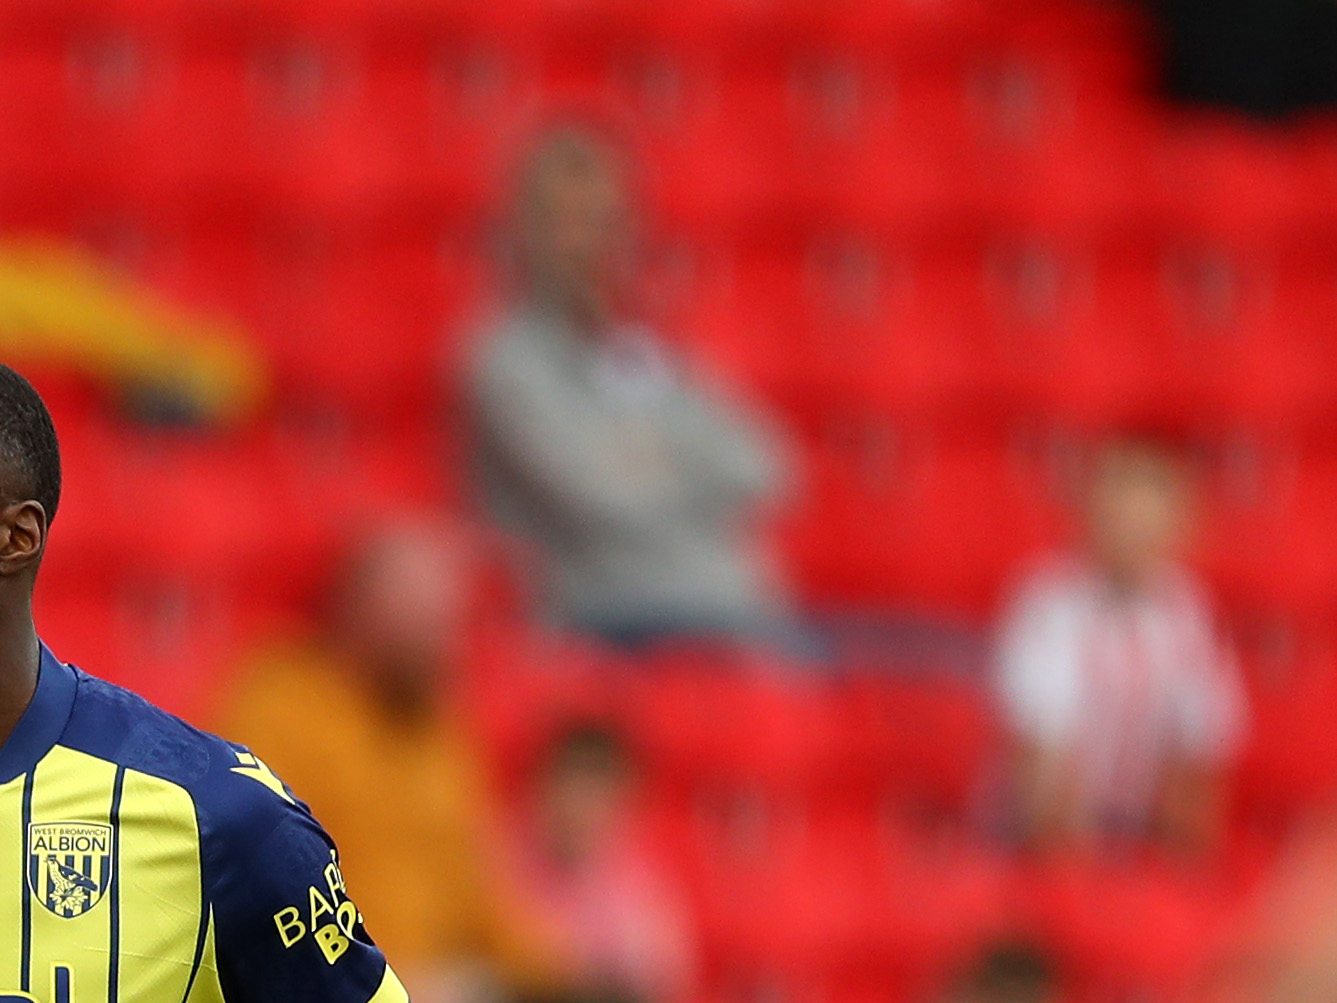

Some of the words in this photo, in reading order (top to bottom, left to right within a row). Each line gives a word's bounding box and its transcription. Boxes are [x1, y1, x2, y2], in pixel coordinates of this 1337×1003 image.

[34, 828, 57, 836] WEST
[60, 828, 107, 837] BROMWICH
[33, 835, 106, 852] ALBION
